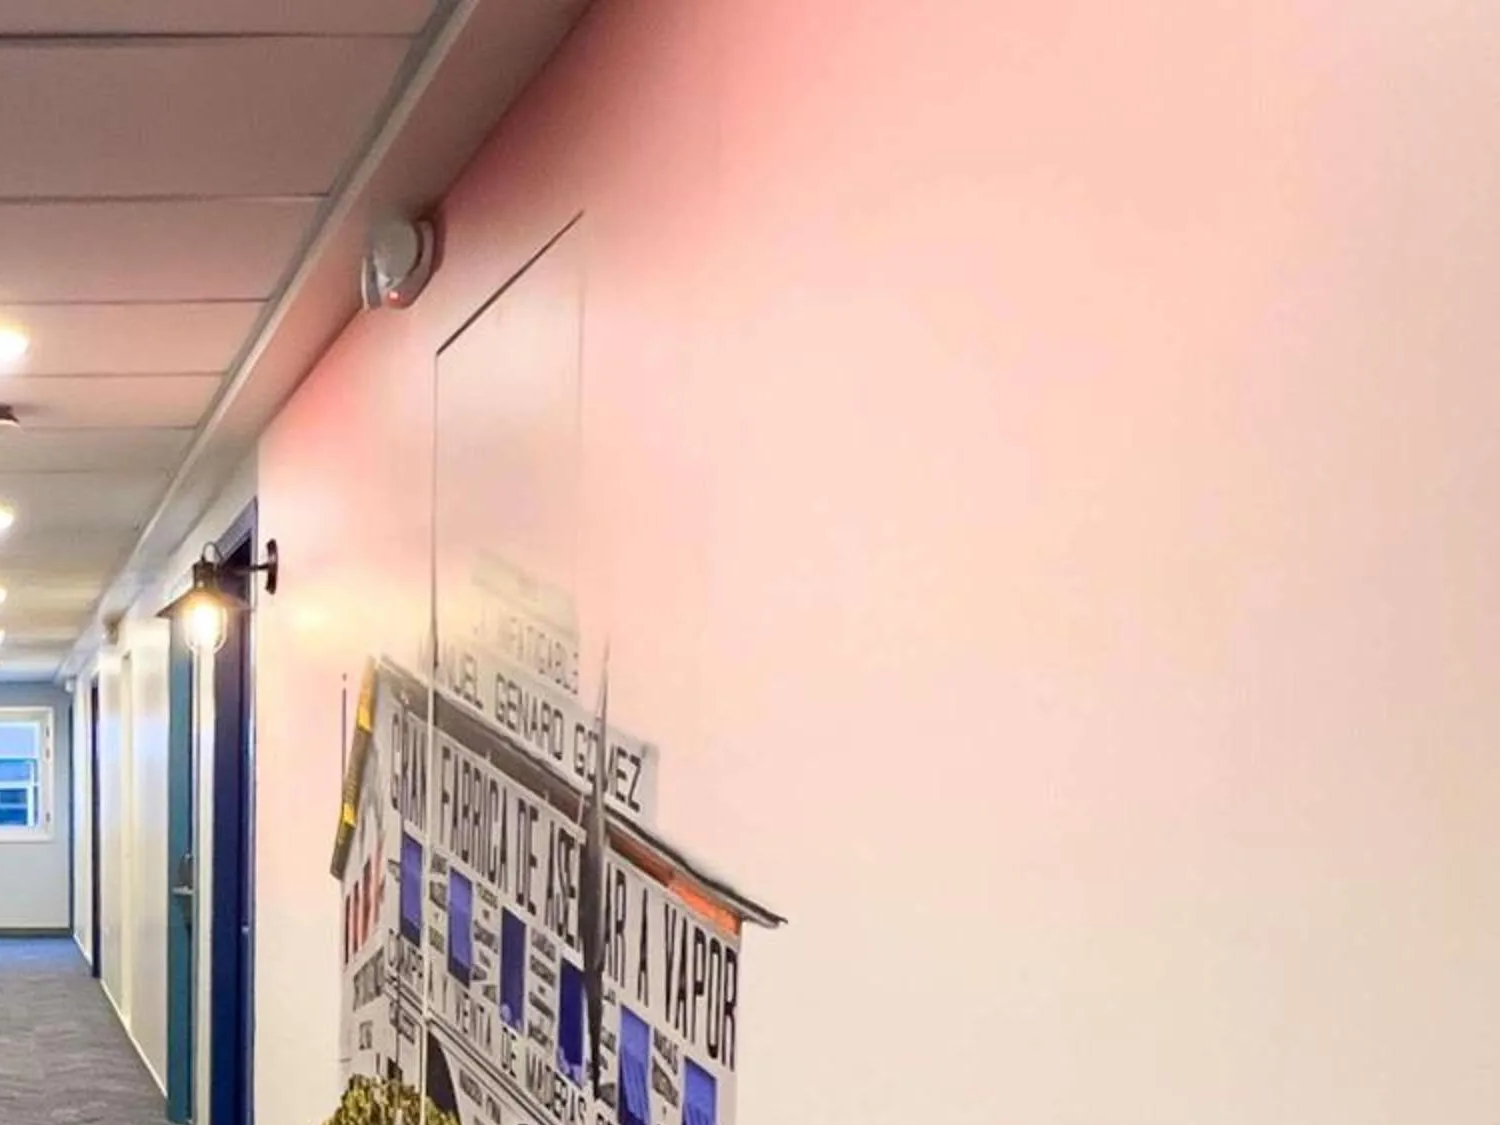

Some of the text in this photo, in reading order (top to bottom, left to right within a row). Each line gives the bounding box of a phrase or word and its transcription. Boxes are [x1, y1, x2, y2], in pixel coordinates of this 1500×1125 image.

[495, 672, 565, 761] GENARO
[439, 745, 509, 895] FABRICA
[516, 797, 538, 917] DE
[636, 888, 649, 1009] A
[664, 902, 738, 1074] VAPOR
[501, 1026, 517, 1078] DE
